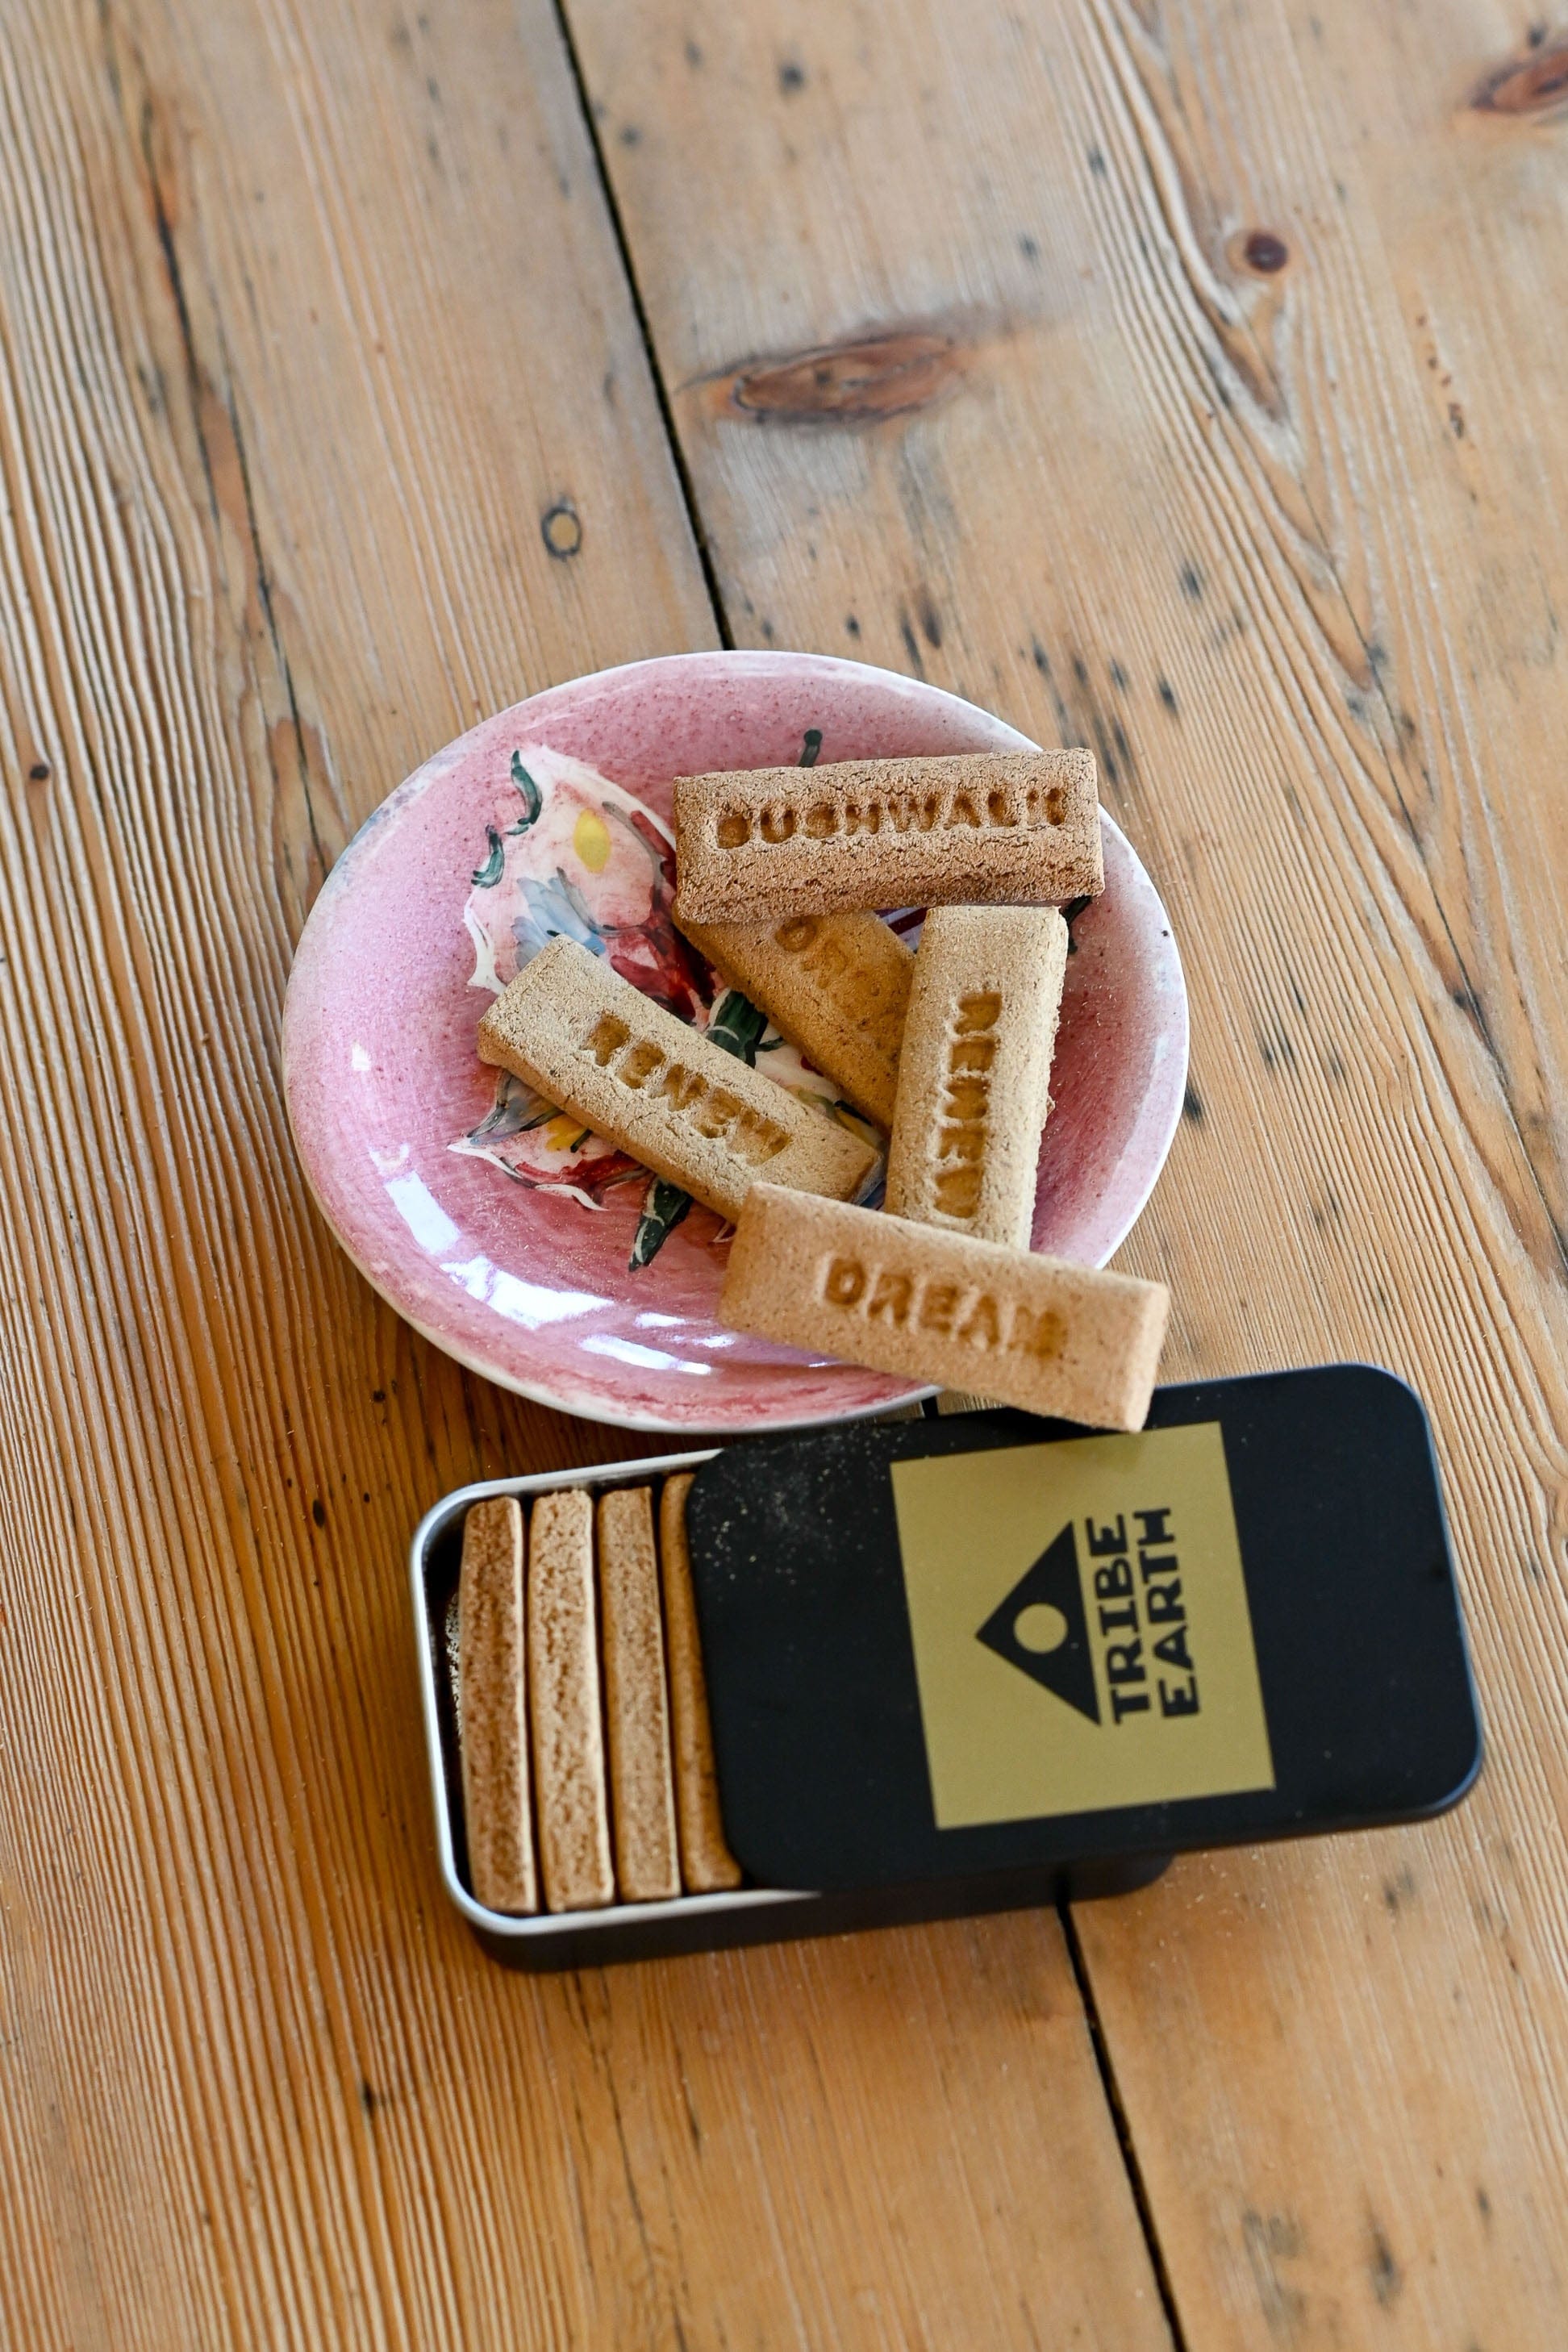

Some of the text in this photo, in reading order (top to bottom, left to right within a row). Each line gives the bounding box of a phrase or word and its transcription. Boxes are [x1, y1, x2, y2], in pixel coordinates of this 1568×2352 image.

[824, 1257, 1069, 1358] DREAM
[1086, 1513, 1151, 1725] TRIBE
[1133, 1507, 1200, 1718] EARTH
